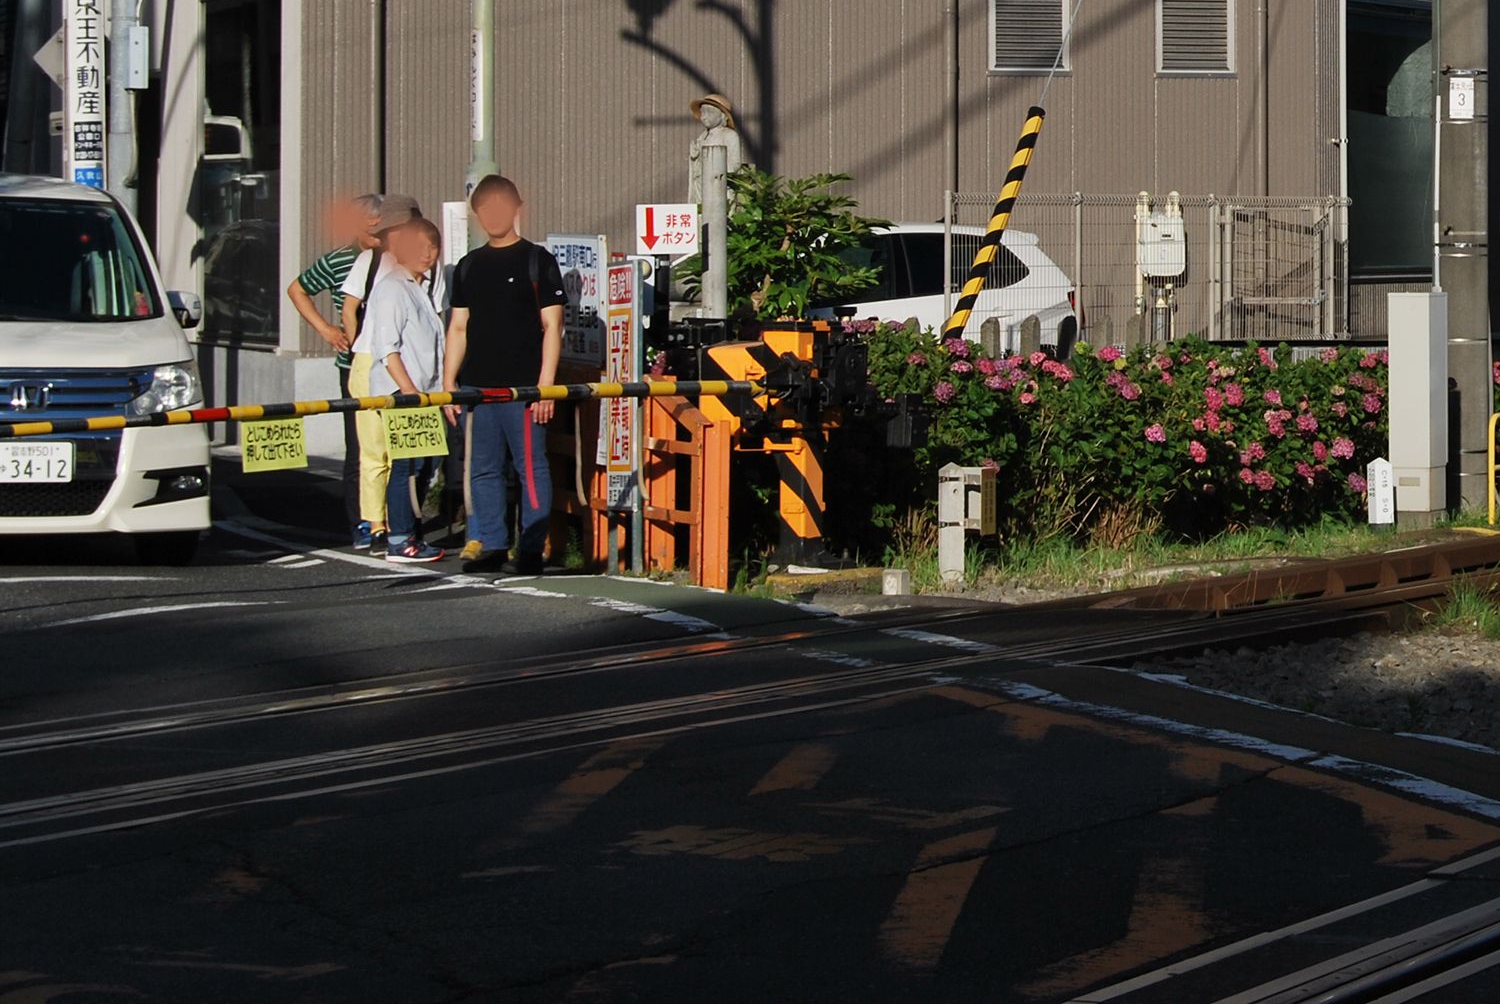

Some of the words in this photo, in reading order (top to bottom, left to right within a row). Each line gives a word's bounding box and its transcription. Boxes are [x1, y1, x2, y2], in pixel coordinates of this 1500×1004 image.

[1458, 92, 1466, 106] 3
[666, 213, 691, 228] 非常
[662, 231, 696, 245] ボタン
[611, 320, 621, 461] 立入禁止
[388, 413, 440, 432] とじこめられたら
[247, 423, 301, 443] とじこめられたら
[389, 431, 443, 450] 押して出て下さい
[247, 442, 303, 462] 押して出て下さい
[11, 459, 67, 478] 34-12
